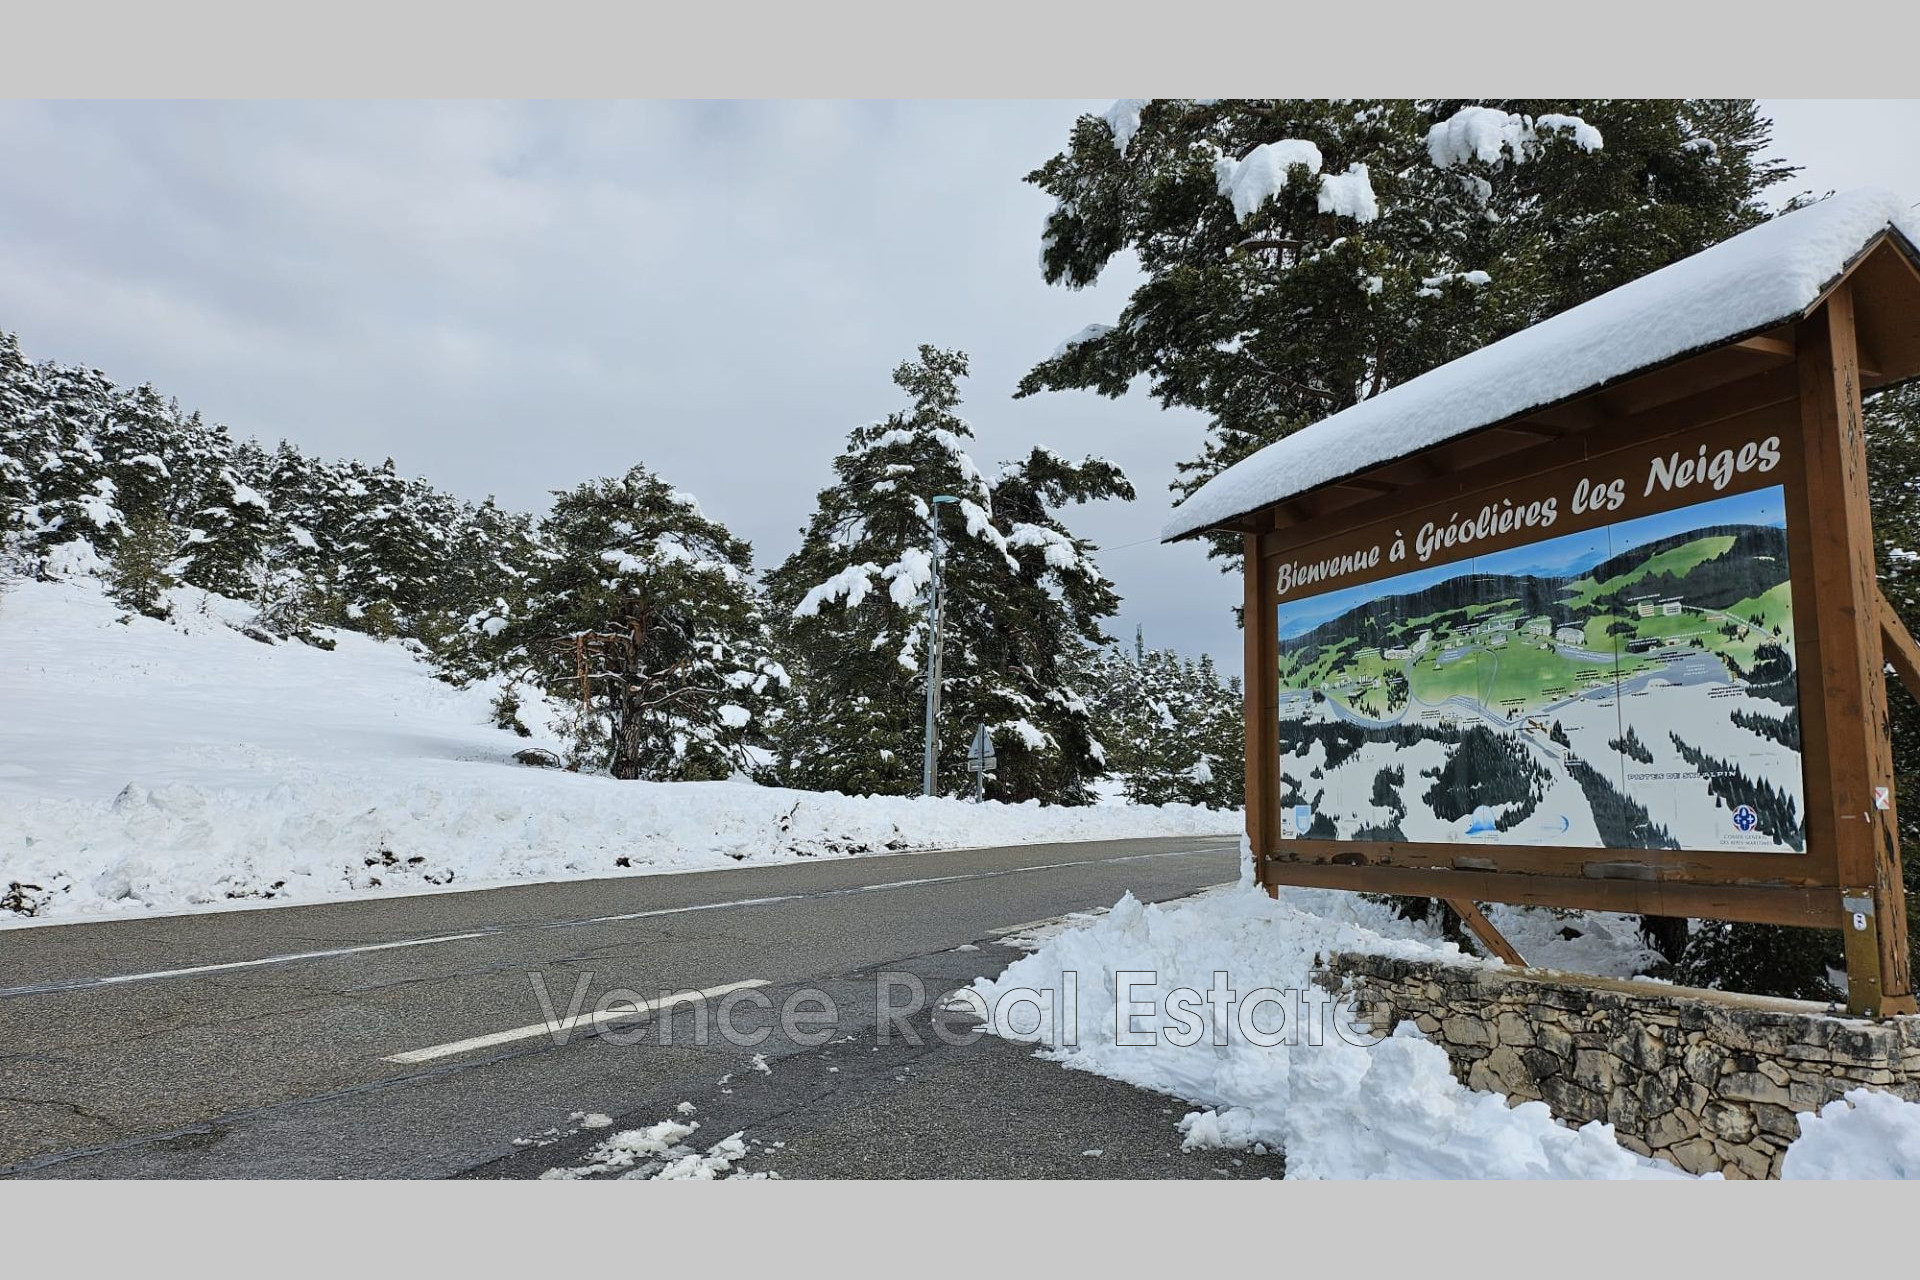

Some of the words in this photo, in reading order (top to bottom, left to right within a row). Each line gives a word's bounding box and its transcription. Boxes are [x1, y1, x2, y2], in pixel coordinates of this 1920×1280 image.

[1276, 545, 1380, 595] Bienvenue
[1389, 530, 1406, 563] à
[1415, 497, 1558, 562] Gréolières
[1571, 478, 1626, 515] les
[1643, 436, 1781, 497] Neiges
[1627, 773, 1664, 781] PISTES
[1702, 770, 1737, 779] ALPIN
